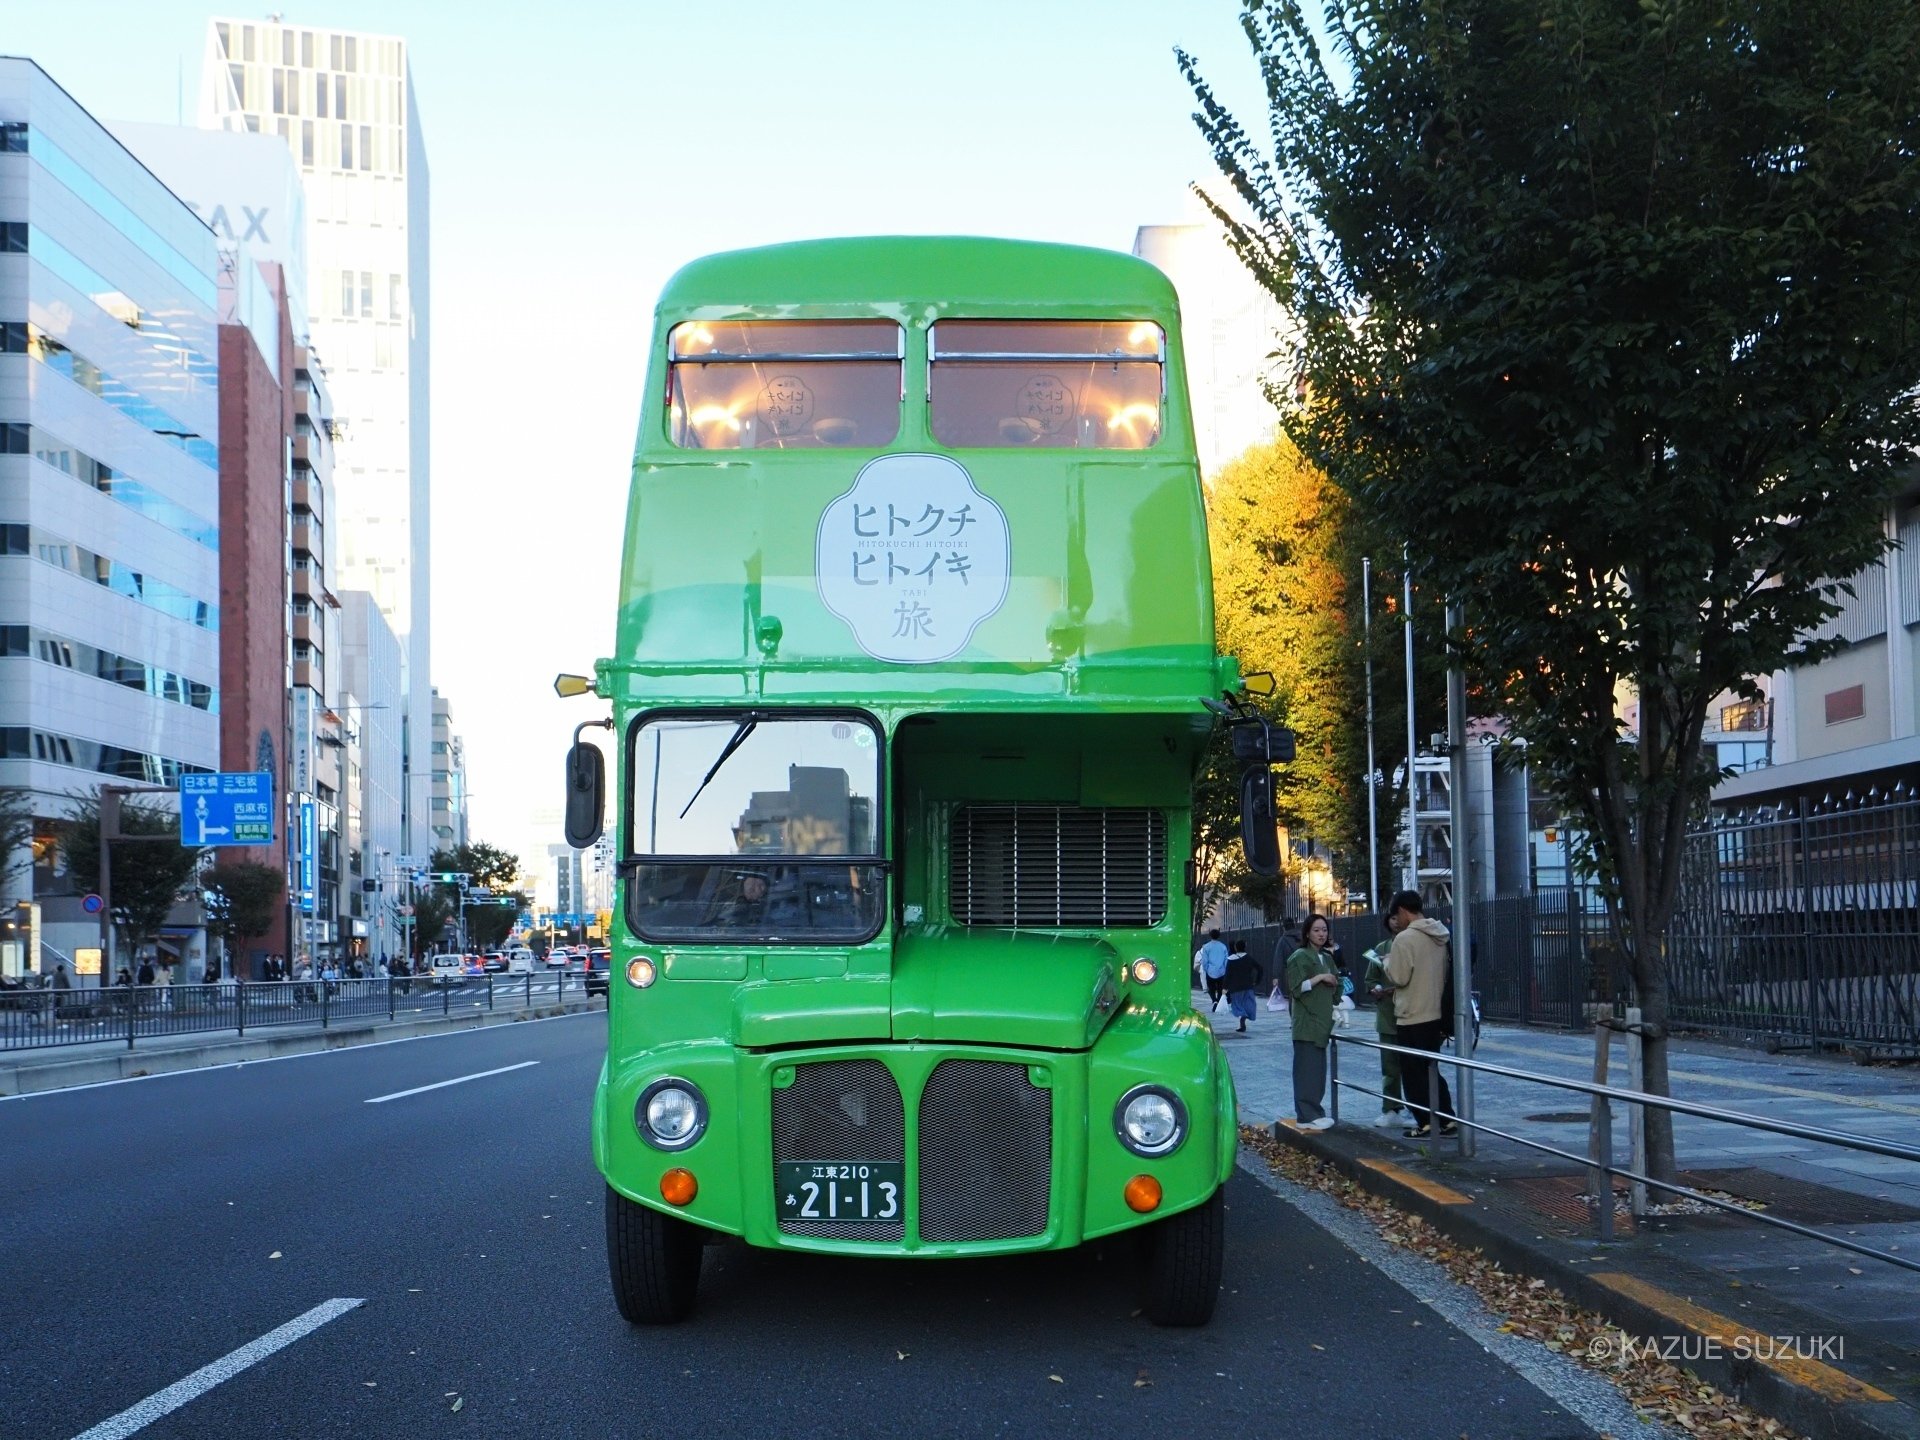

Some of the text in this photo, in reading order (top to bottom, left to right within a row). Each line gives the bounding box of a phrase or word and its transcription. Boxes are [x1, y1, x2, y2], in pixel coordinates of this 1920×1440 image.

[853, 503, 977, 537] ヒトクチ
[858, 540, 969, 548] HITOKUCHI HITOIKI
[852, 551, 972, 586] ヒトイキ
[902, 589, 927, 597] TABI
[891, 600, 936, 640] 旅
[184, 775, 257, 788] 日本橋 三宅坂
[234, 802, 268, 813] 西麻布
[785, 1181, 897, 1218] あ 21-13
